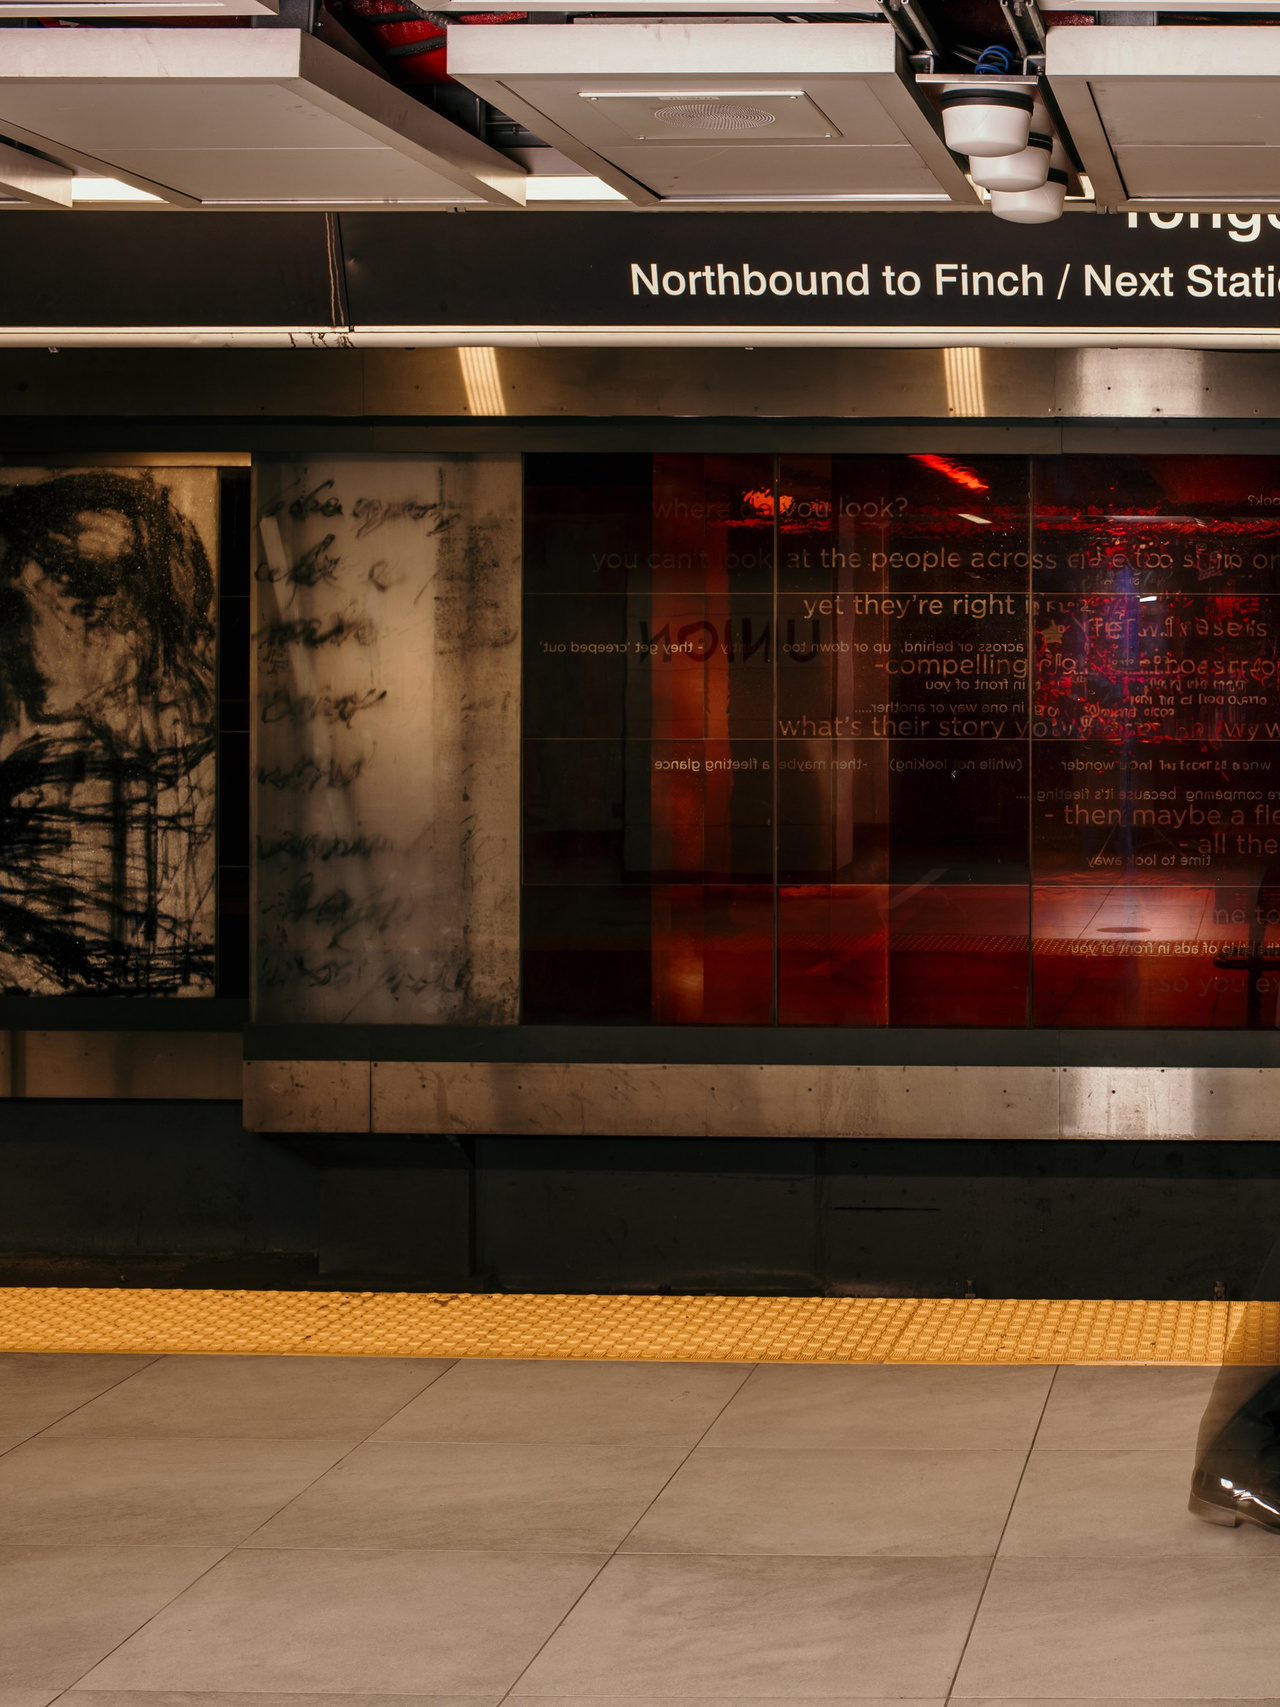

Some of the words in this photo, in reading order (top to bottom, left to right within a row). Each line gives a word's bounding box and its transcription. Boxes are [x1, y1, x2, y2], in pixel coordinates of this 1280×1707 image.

[630, 263, 869, 297] Northbound
[883, 265, 921, 297] to
[936, 264, 1044, 297] Finch
[1057, 264, 1070, 300] /
[1084, 265, 1174, 297] Next
[651, 497, 731, 519] where
[783, 500, 830, 522] you
[839, 496, 908, 519] look?
[592, 552, 638, 573] you
[646, 549, 709, 569] can't
[719, 548, 774, 569] look
[786, 550, 811, 569] at
[820, 548, 862, 569] the
[872, 547, 962, 572] people
[970, 552, 1057, 570] across
[804, 595, 844, 619] yet
[853, 594, 944, 619] they're
[954, 594, 1016, 619] right
[779, 715, 862, 737] what's
[872, 714, 930, 737] their
[939, 718, 1006, 741] story
[1064, 804, 1122, 826] then
[1133, 804, 1221, 829] maybe
[1231, 809, 1245, 826] a
[1199, 834, 1226, 855] all
[1236, 834, 1279, 856] the
